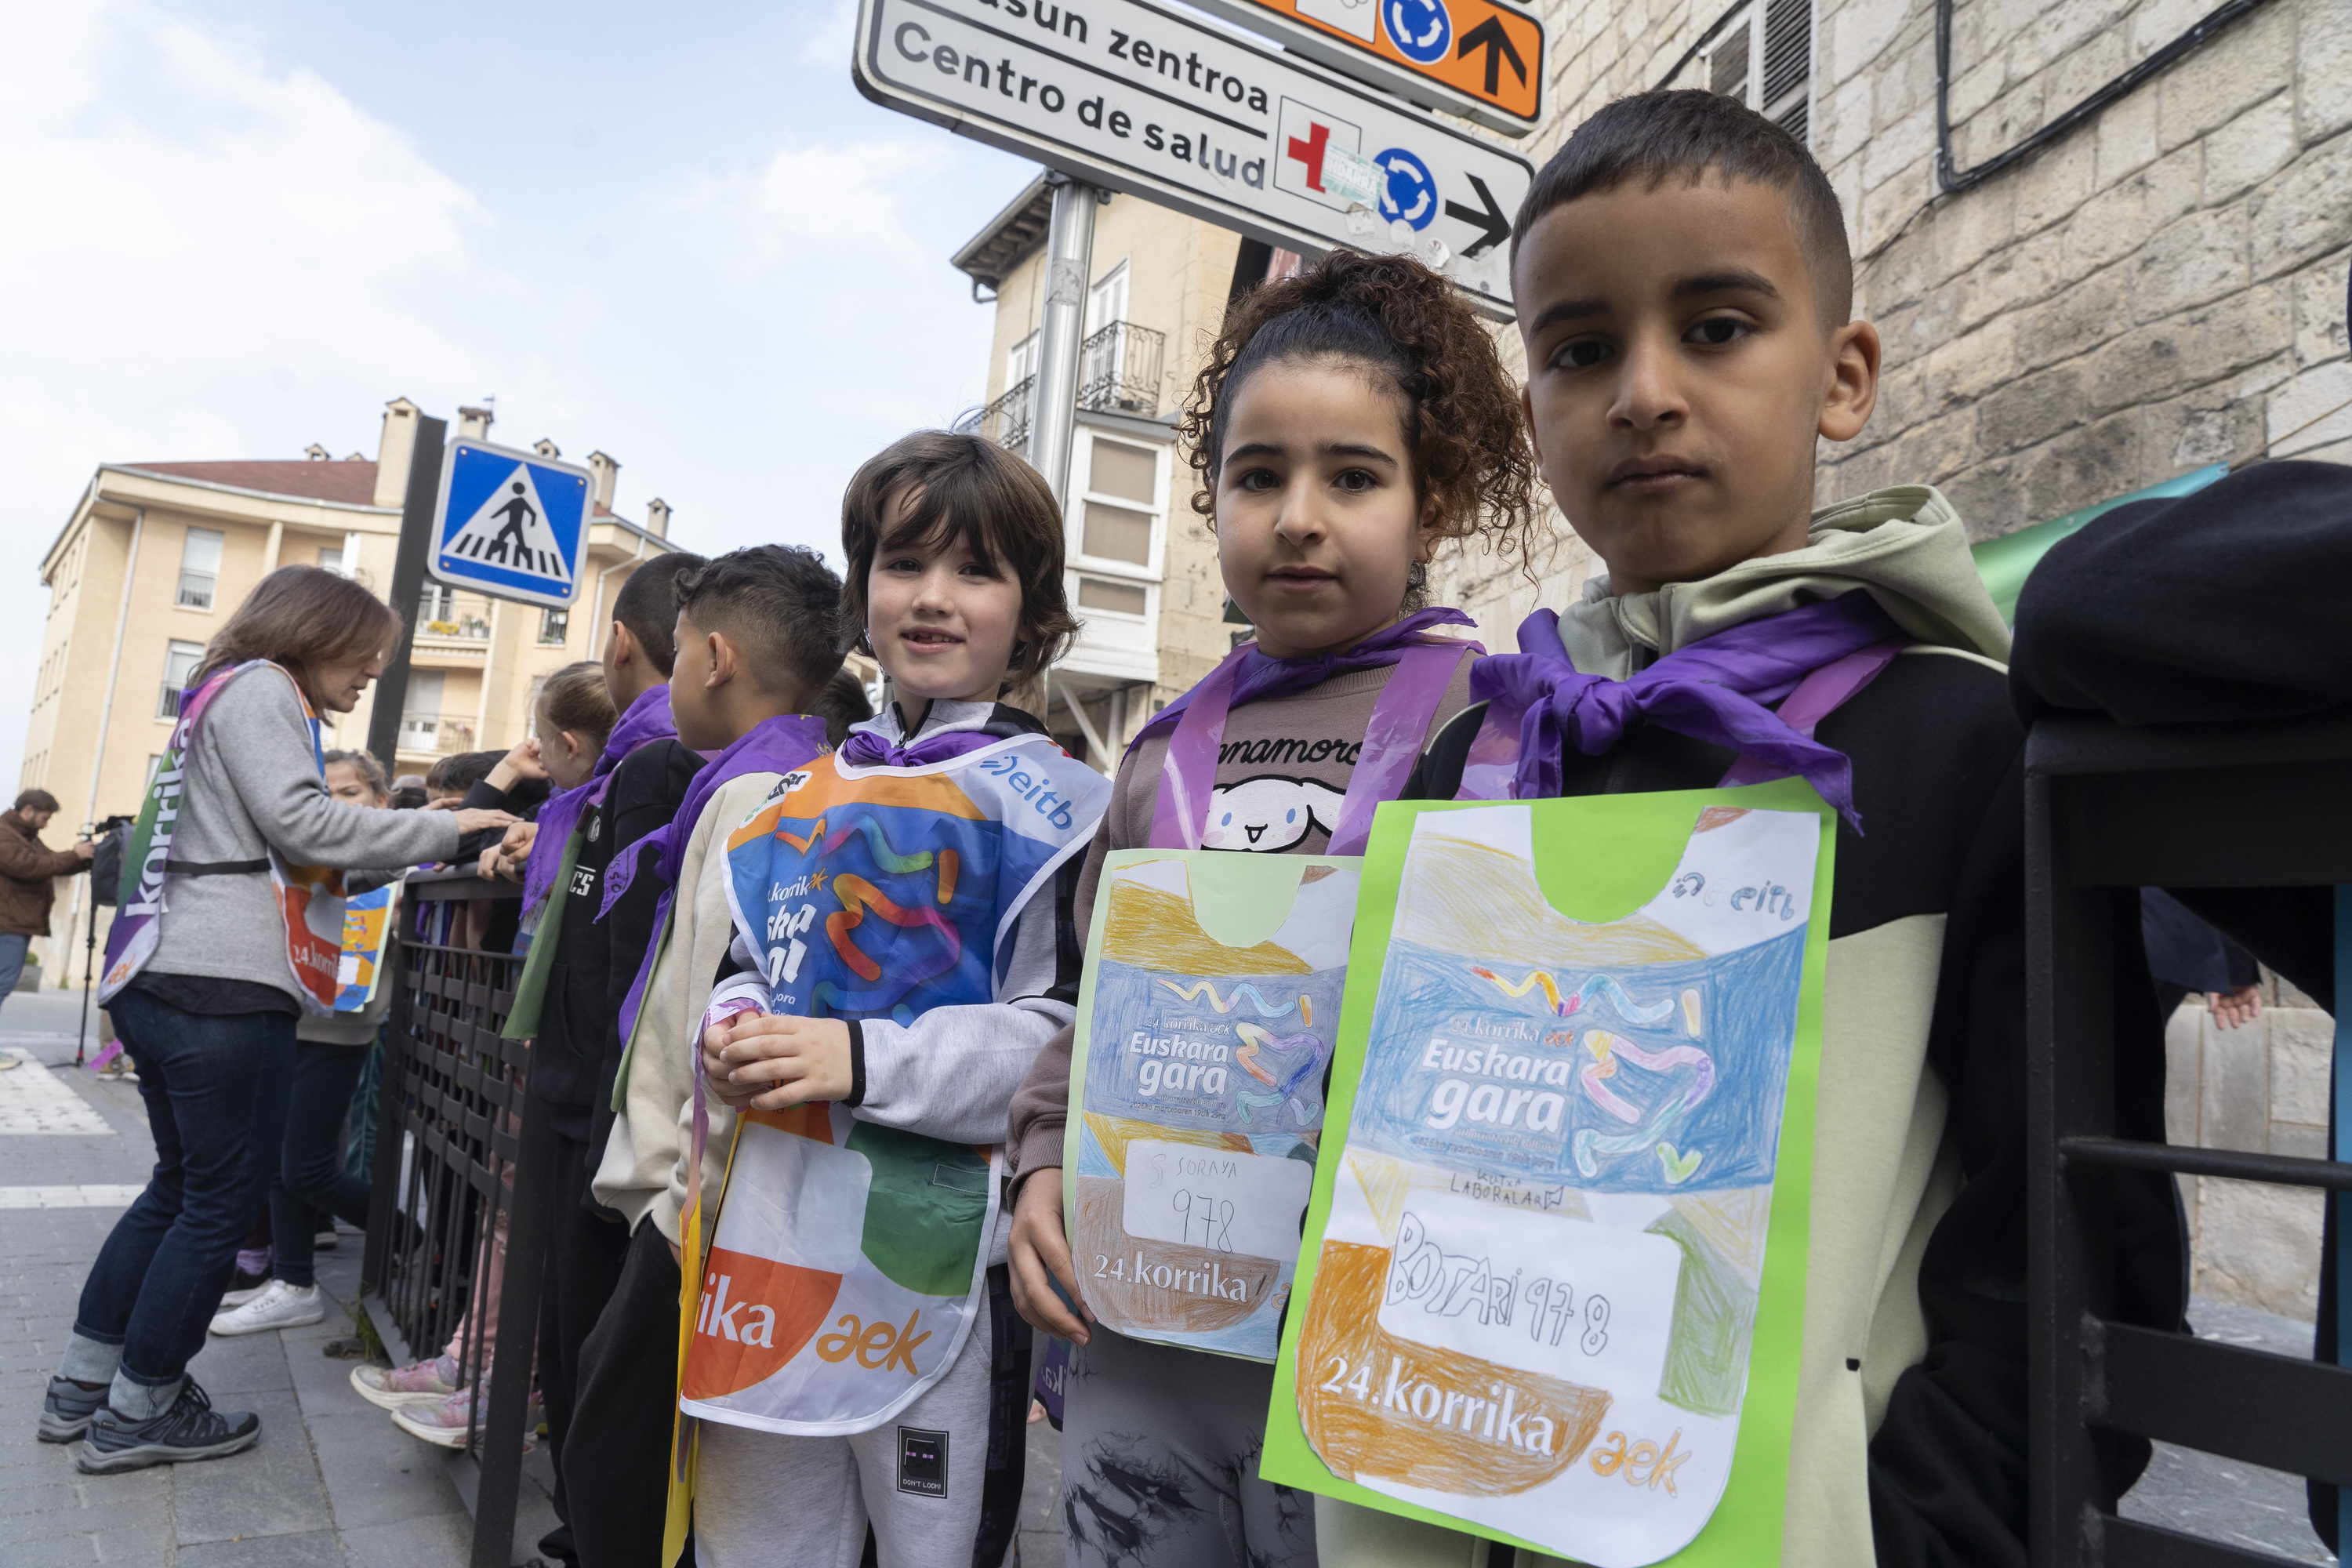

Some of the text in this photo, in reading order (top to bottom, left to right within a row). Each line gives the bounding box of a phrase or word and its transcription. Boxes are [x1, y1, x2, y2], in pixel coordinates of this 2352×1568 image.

[978, 0, 1269, 115] sun zentroa
[895, 21, 1065, 114] Centro
[1077, 95, 1132, 138] de
[1143, 123, 1266, 191] salud
[125, 717, 191, 917] korrika
[1008, 771, 1073, 830] eitb
[1130, 1031, 1230, 1063] Euskara
[1146, 1014, 1208, 1033] 24.korrika
[1451, 1016, 1541, 1043] 24.korrika
[1137, 1058, 1229, 1097] gara
[1421, 1036, 1573, 1087] Euskara
[1425, 1077, 1567, 1134] gara
[1173, 1189, 1236, 1255] 978
[1094, 1250, 1248, 1303] 24.korrika
[815, 1308, 932, 1376] aek
[1319, 1355, 1692, 1498] 24.korrika aek
